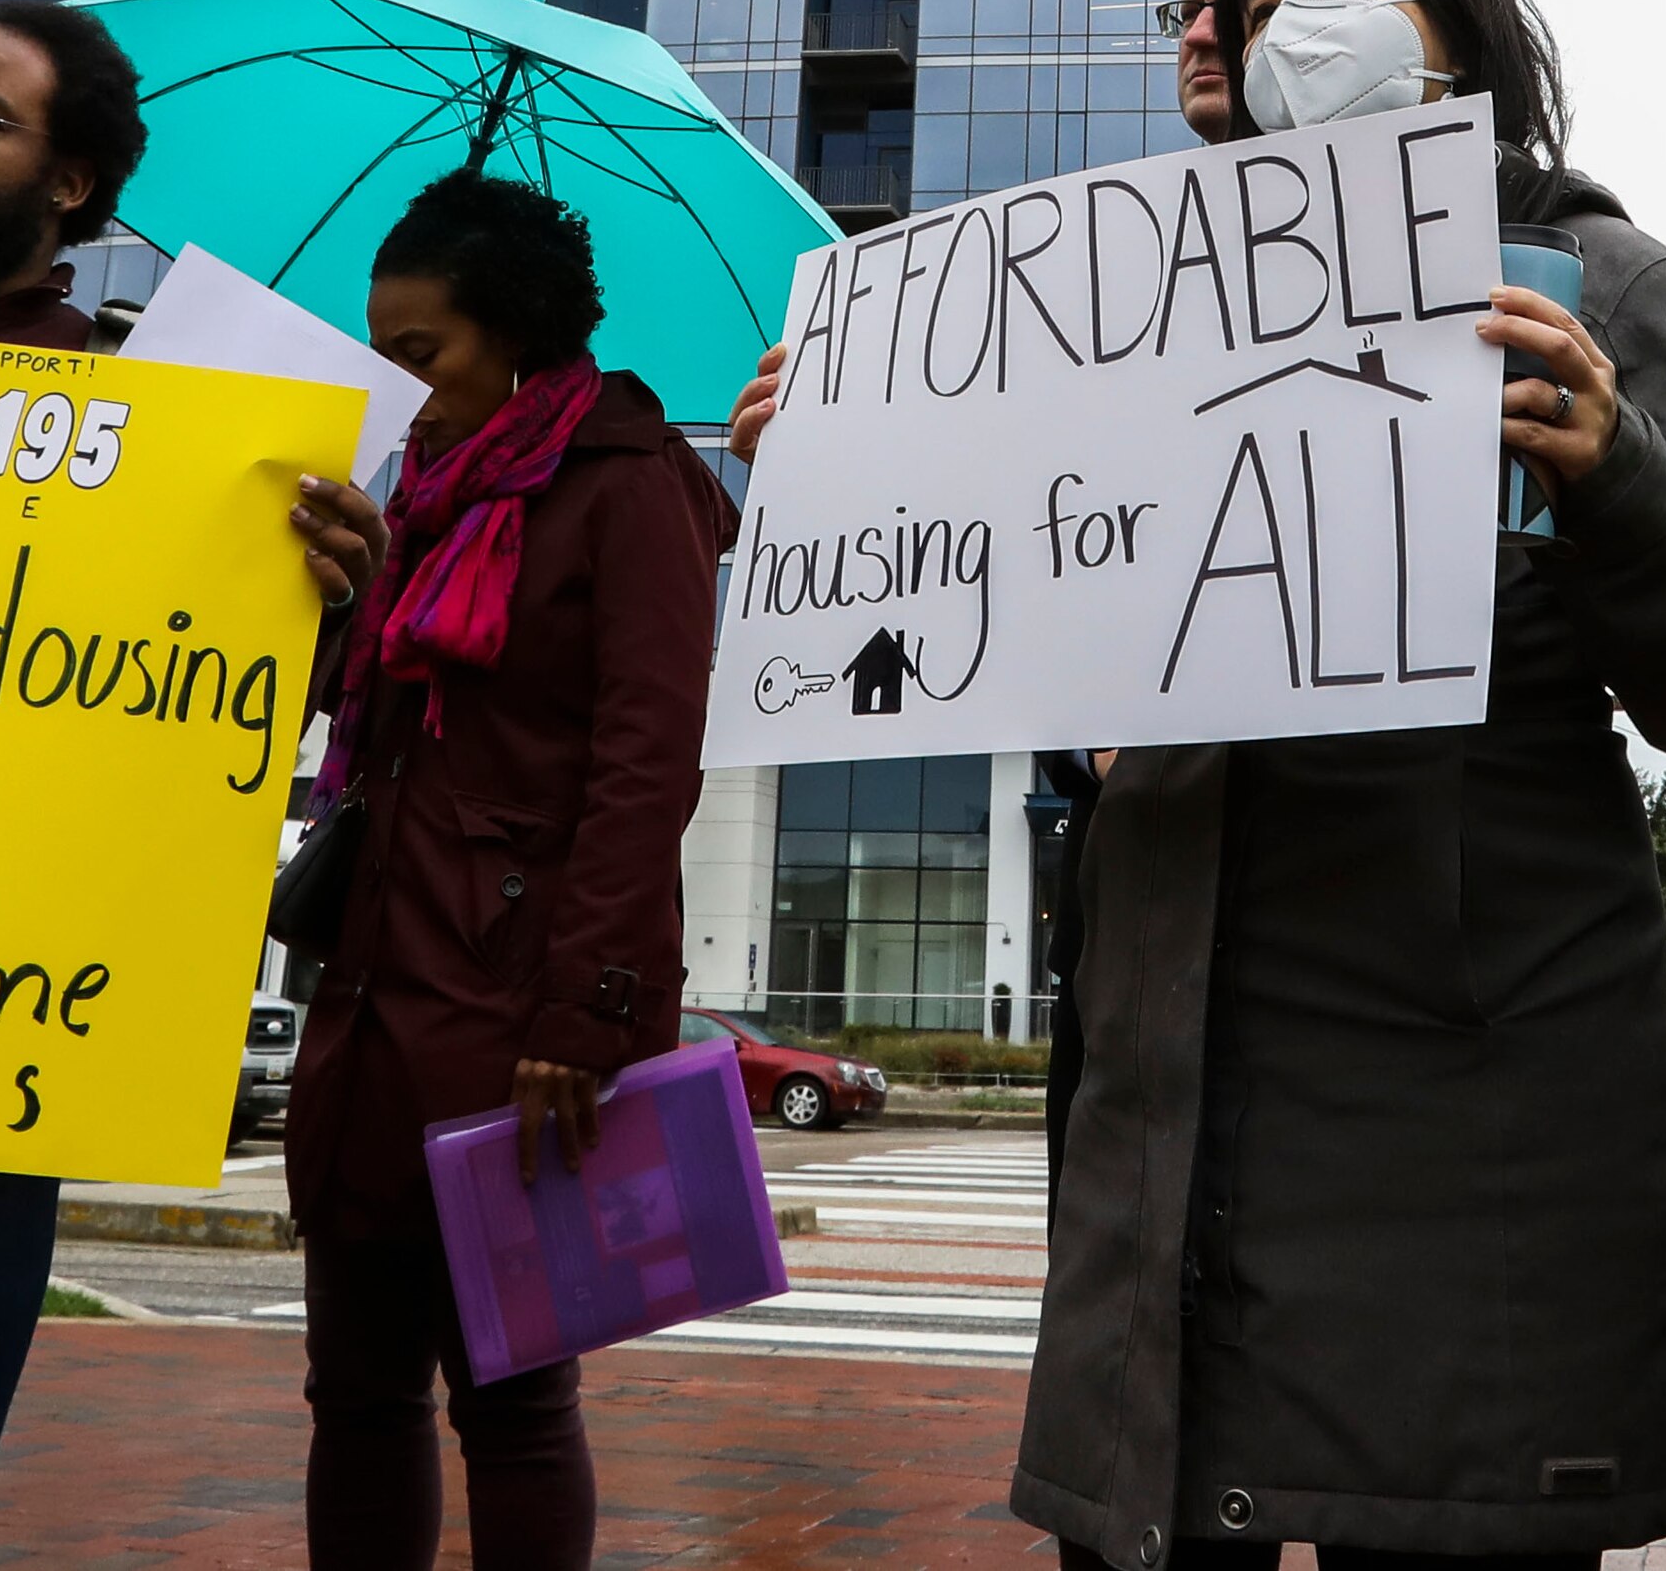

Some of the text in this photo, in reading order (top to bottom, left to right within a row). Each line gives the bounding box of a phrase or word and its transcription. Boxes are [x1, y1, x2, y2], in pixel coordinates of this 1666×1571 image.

[779, 121, 1491, 411] AFFORDABLE
[740, 417, 1477, 701] housing for ALL
